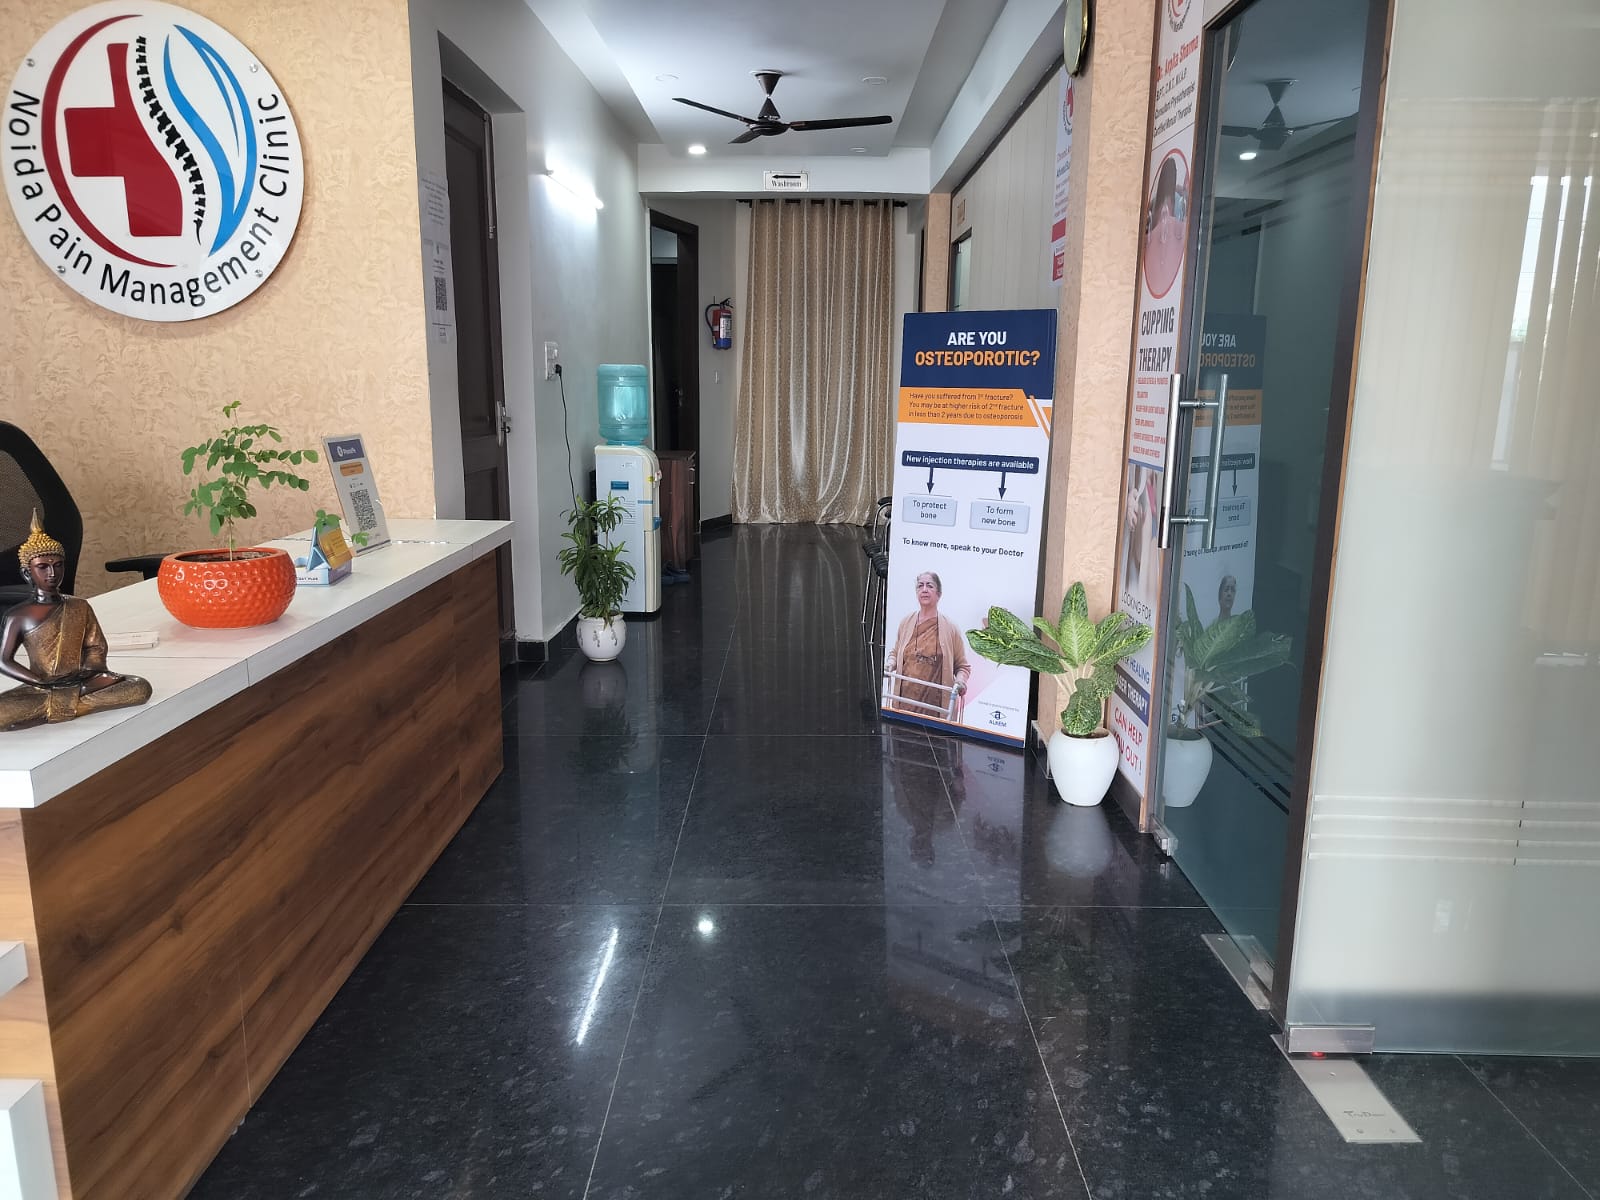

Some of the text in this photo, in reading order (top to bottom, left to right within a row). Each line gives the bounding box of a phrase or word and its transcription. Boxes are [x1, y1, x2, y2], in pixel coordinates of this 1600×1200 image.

[9, 89, 290, 308] Noida Pain Management Clinic
[1141, 306, 1175, 336] CUPPING
[947, 331, 1007, 346] ARE YOU
[915, 350, 1041, 366] OSTEOPOROTIC?
[1138, 346, 1173, 373] THERAPY
[925, 393, 936, 401] you
[984, 393, 1014, 401] fracture?
[949, 402, 968, 411] higher
[983, 413, 1024, 421] osteoporosis
[906, 455, 921, 463] New
[922, 455, 953, 465] injection
[953, 457, 987, 467] therapies
[1001, 460, 1034, 469] available
[921, 501, 947, 510] protect
[996, 506, 1014, 515] form
[920, 511, 937, 519] bone
[997, 517, 1017, 527] bone
[903, 537, 1024, 558] To know more, speak to your Doctor
[1121, 591, 1142, 614] LOOKING
[1142, 604, 1152, 620] FOR
[1129, 657, 1150, 685] HEALING
[1127, 682, 1148, 716] THERAPY
[1114, 707, 1142, 746] CAN HELP
